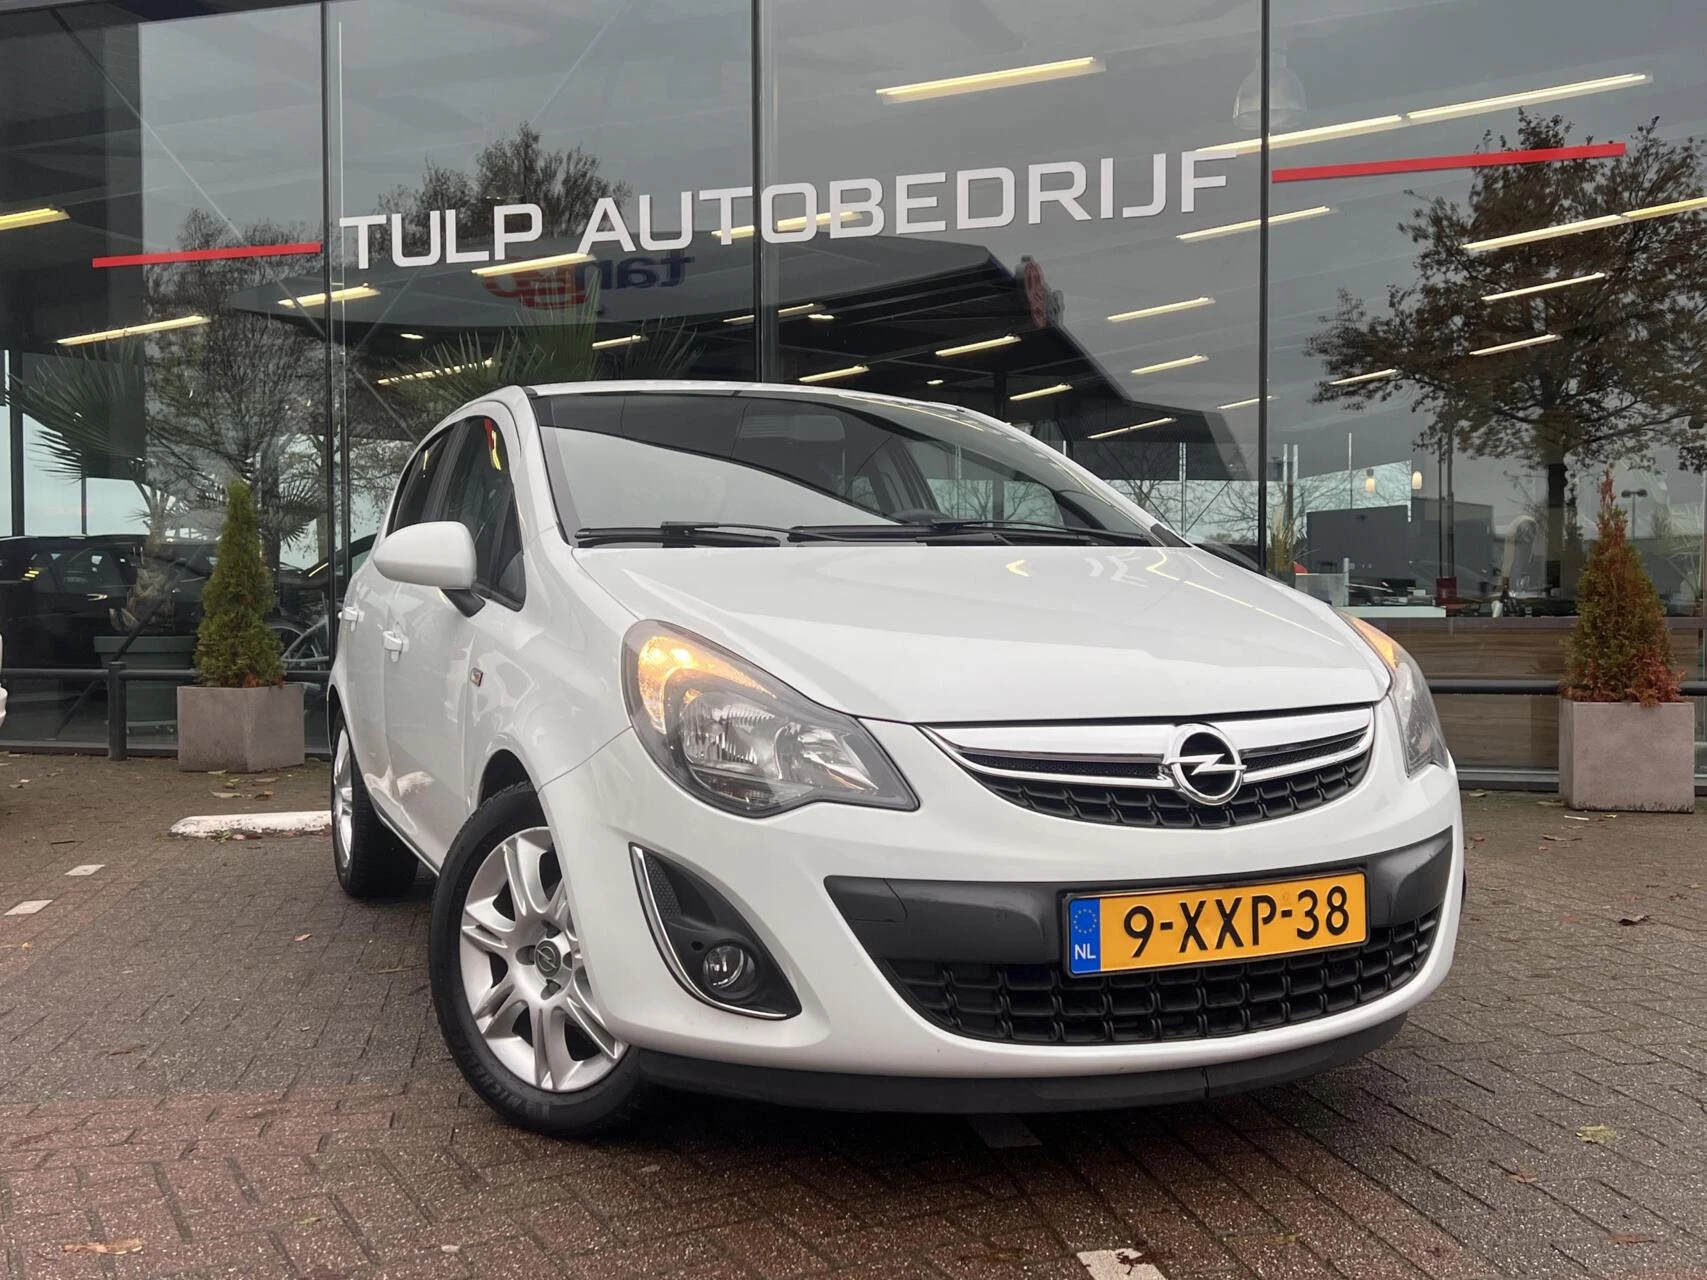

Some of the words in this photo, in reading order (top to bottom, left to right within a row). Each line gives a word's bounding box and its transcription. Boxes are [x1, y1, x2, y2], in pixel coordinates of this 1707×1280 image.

[339, 203, 543, 270] TULP
[577, 150, 1237, 256] AUTOBEDRIJF
[1073, 943, 1096, 960] NL
[1123, 885, 1350, 958] 9-XXP-38
